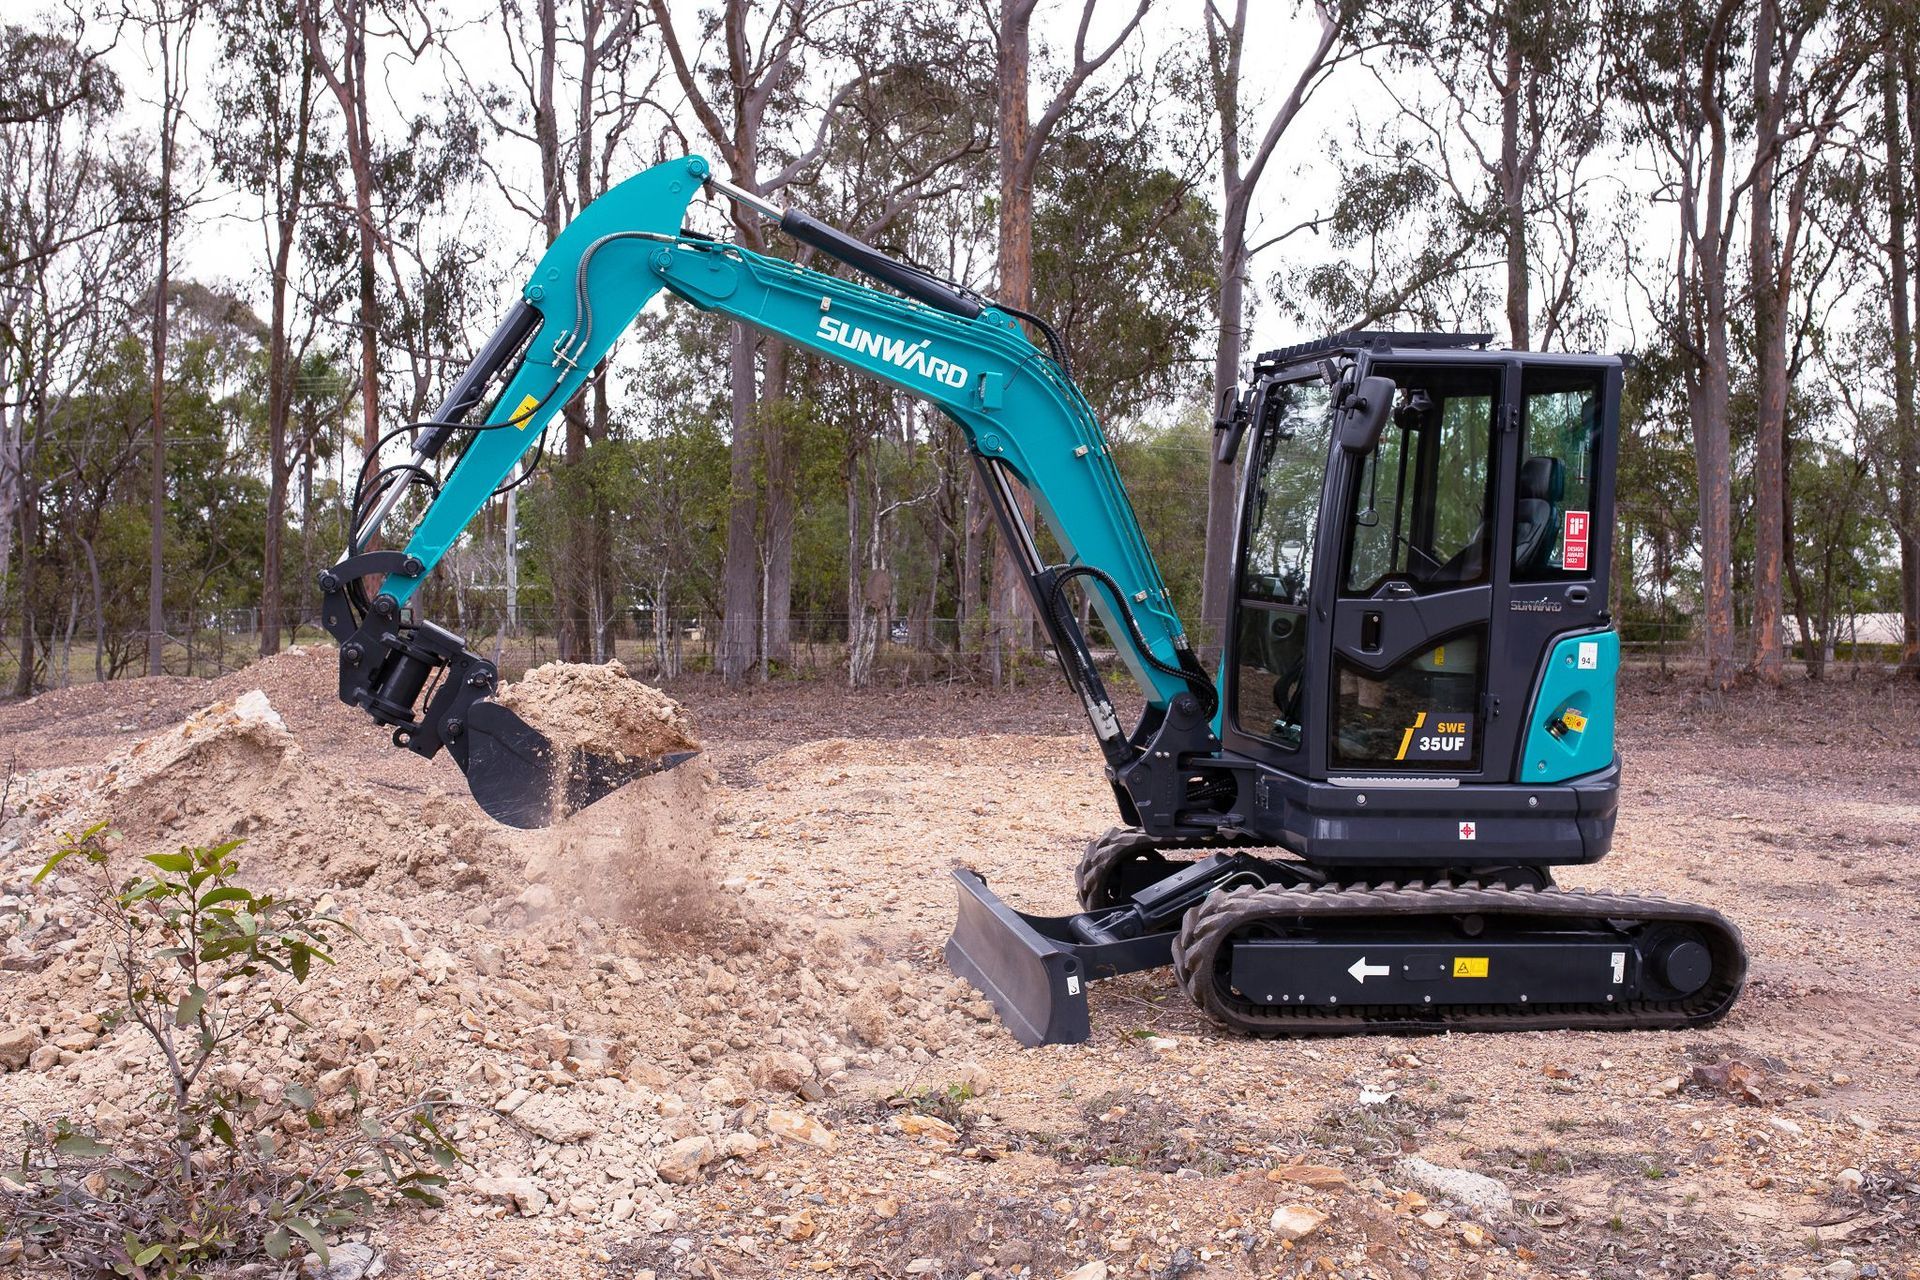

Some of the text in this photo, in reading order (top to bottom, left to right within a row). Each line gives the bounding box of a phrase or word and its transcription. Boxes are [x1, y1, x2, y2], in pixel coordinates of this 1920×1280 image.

[816, 315, 968, 389] SUNWARD
[1510, 596, 1562, 612] SUNWARD
[1581, 656, 1591, 665] 94
[1437, 722, 1466, 733] SWE
[1419, 736, 1465, 751] 35UF
